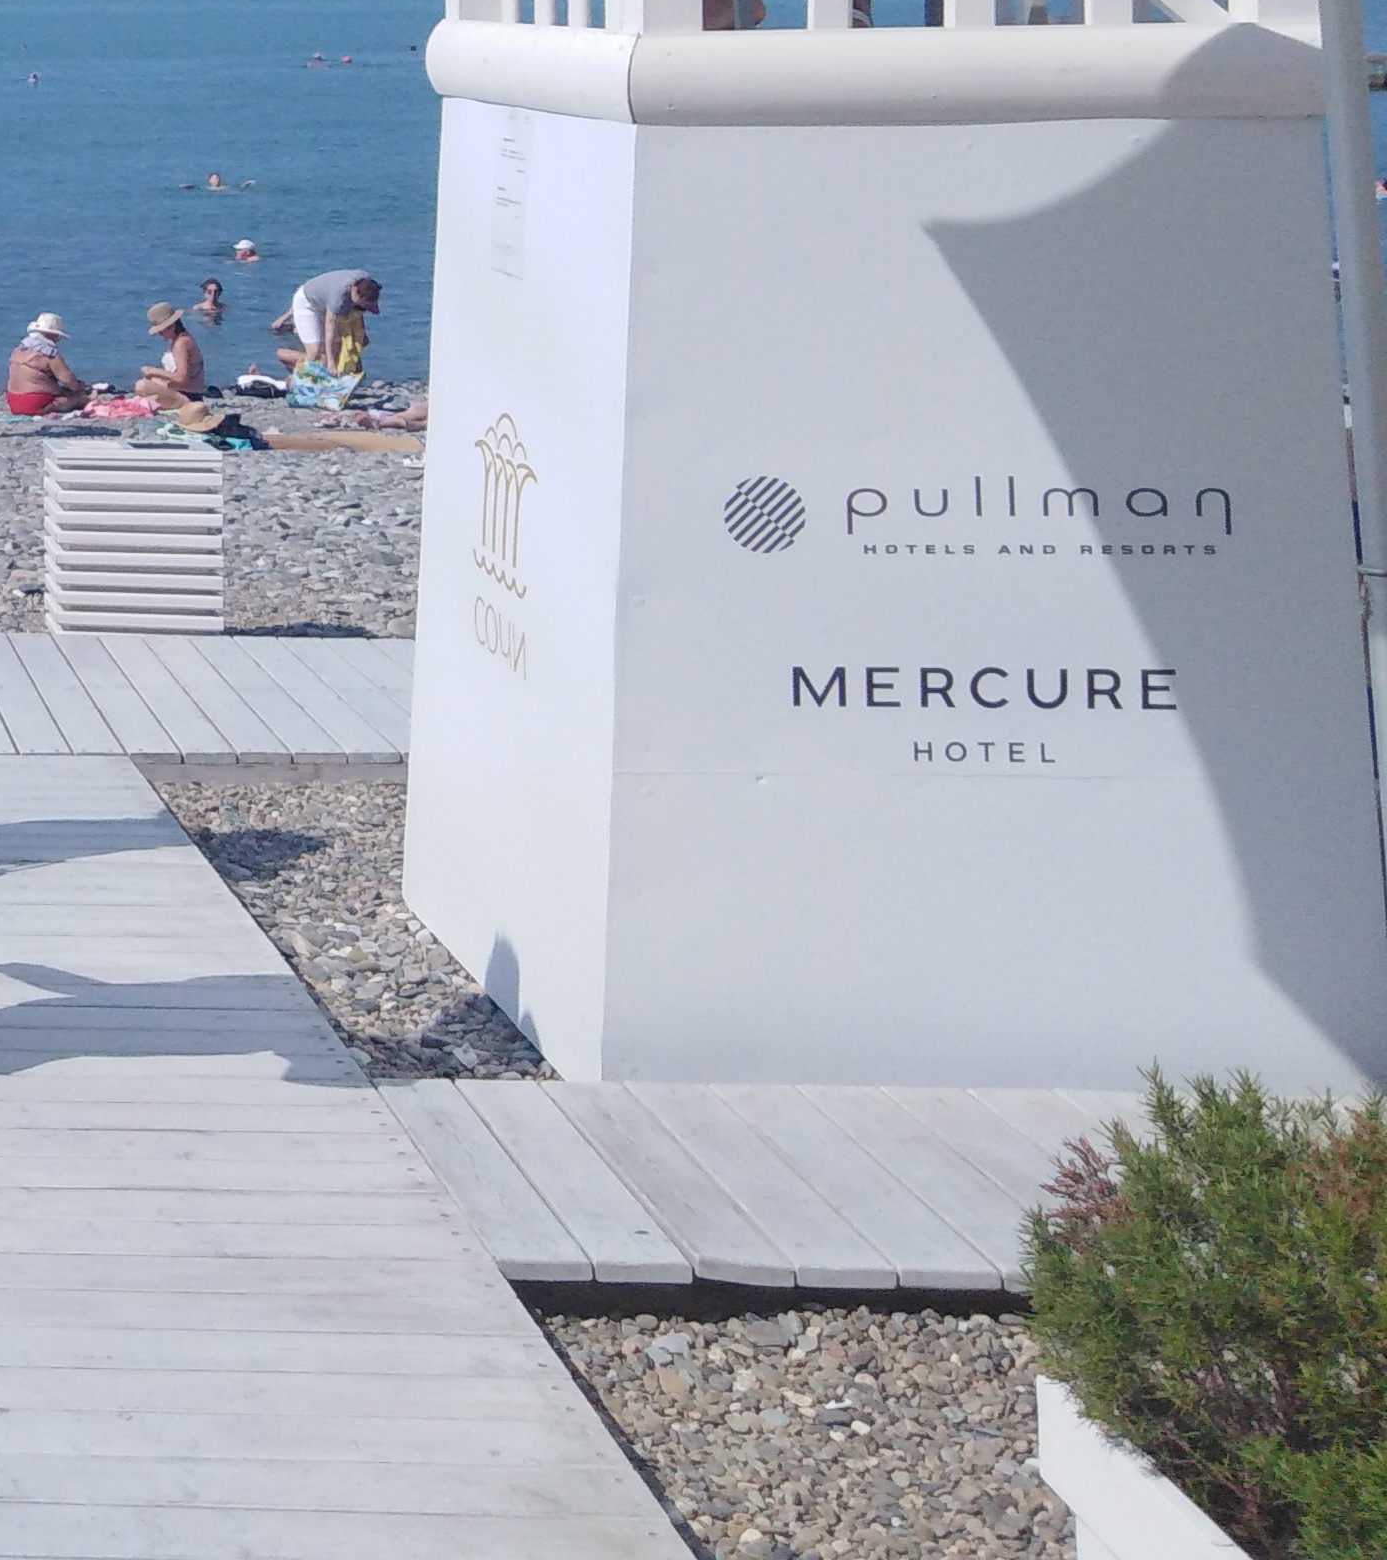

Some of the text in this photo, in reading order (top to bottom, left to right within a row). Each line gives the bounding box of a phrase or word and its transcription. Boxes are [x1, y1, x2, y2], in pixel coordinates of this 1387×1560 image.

[844, 475, 1233, 536] pullman
[862, 543, 1219, 556] HOTELS AND RESORTS
[790, 665, 1179, 712] MERCURE
[912, 740, 1057, 765] HOTEL
